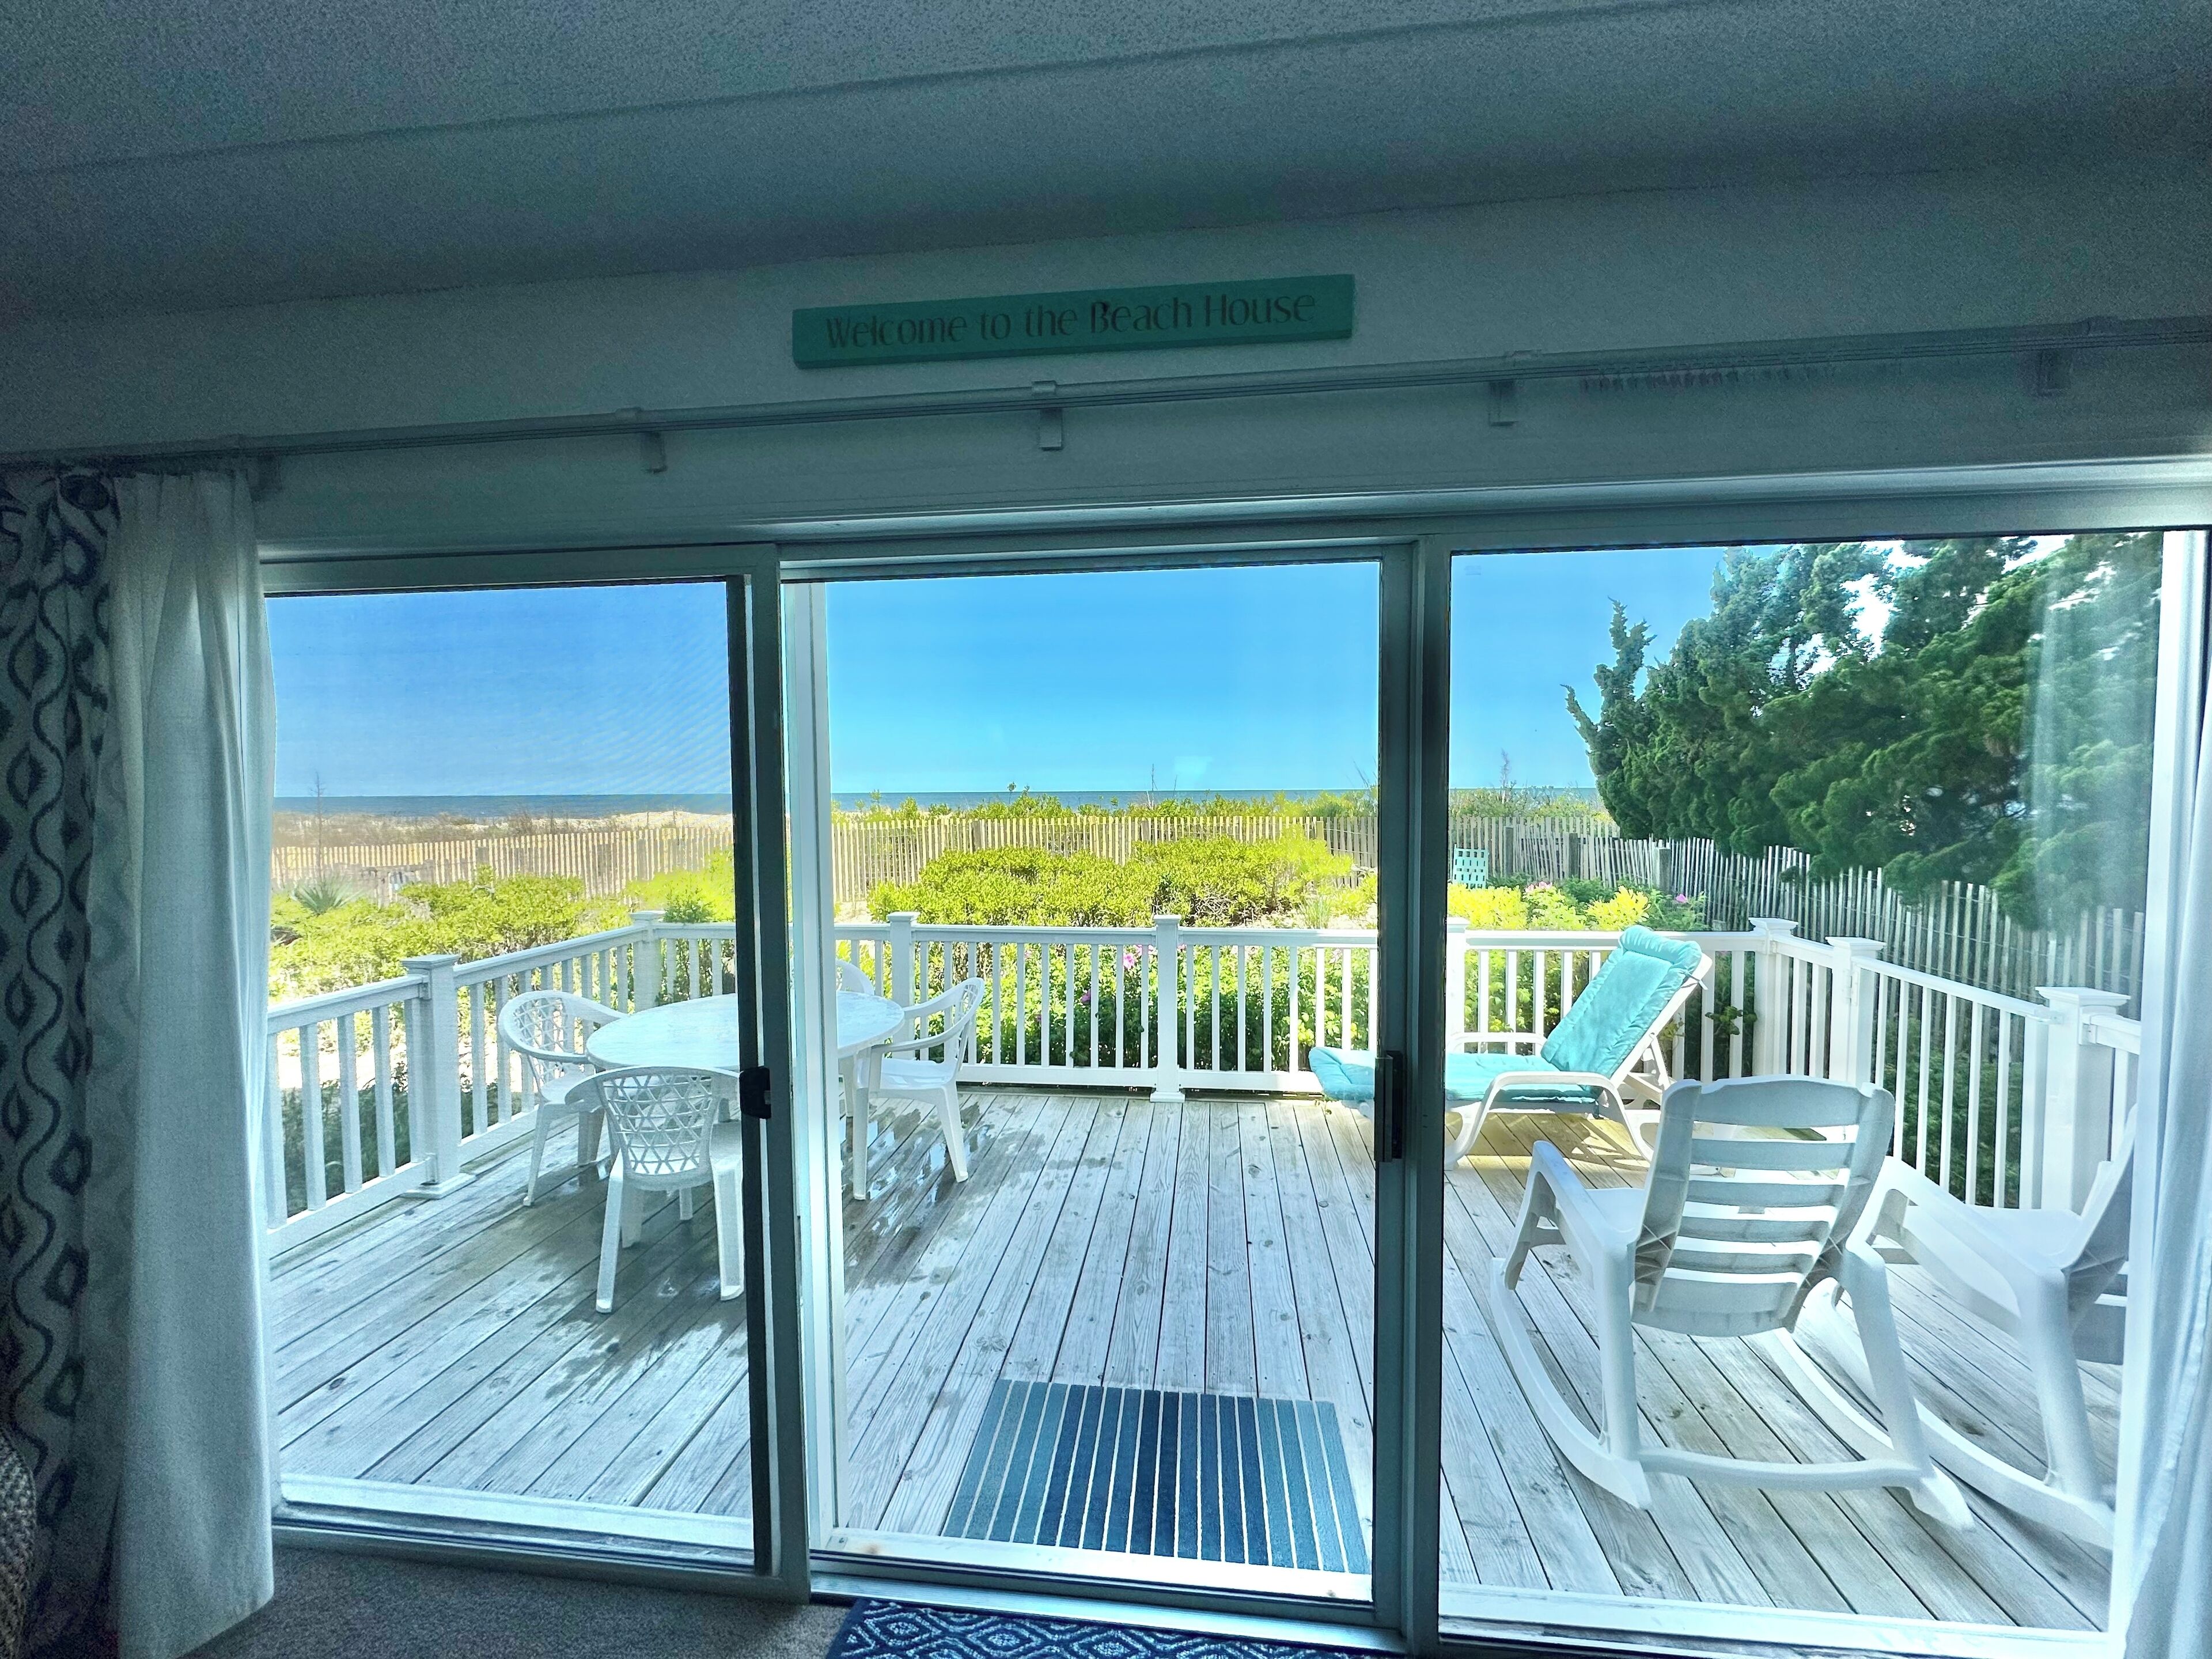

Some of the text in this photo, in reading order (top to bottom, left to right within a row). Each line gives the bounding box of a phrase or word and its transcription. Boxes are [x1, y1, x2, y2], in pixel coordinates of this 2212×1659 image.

[825, 293, 1316, 348] Welcome to the Beach House
